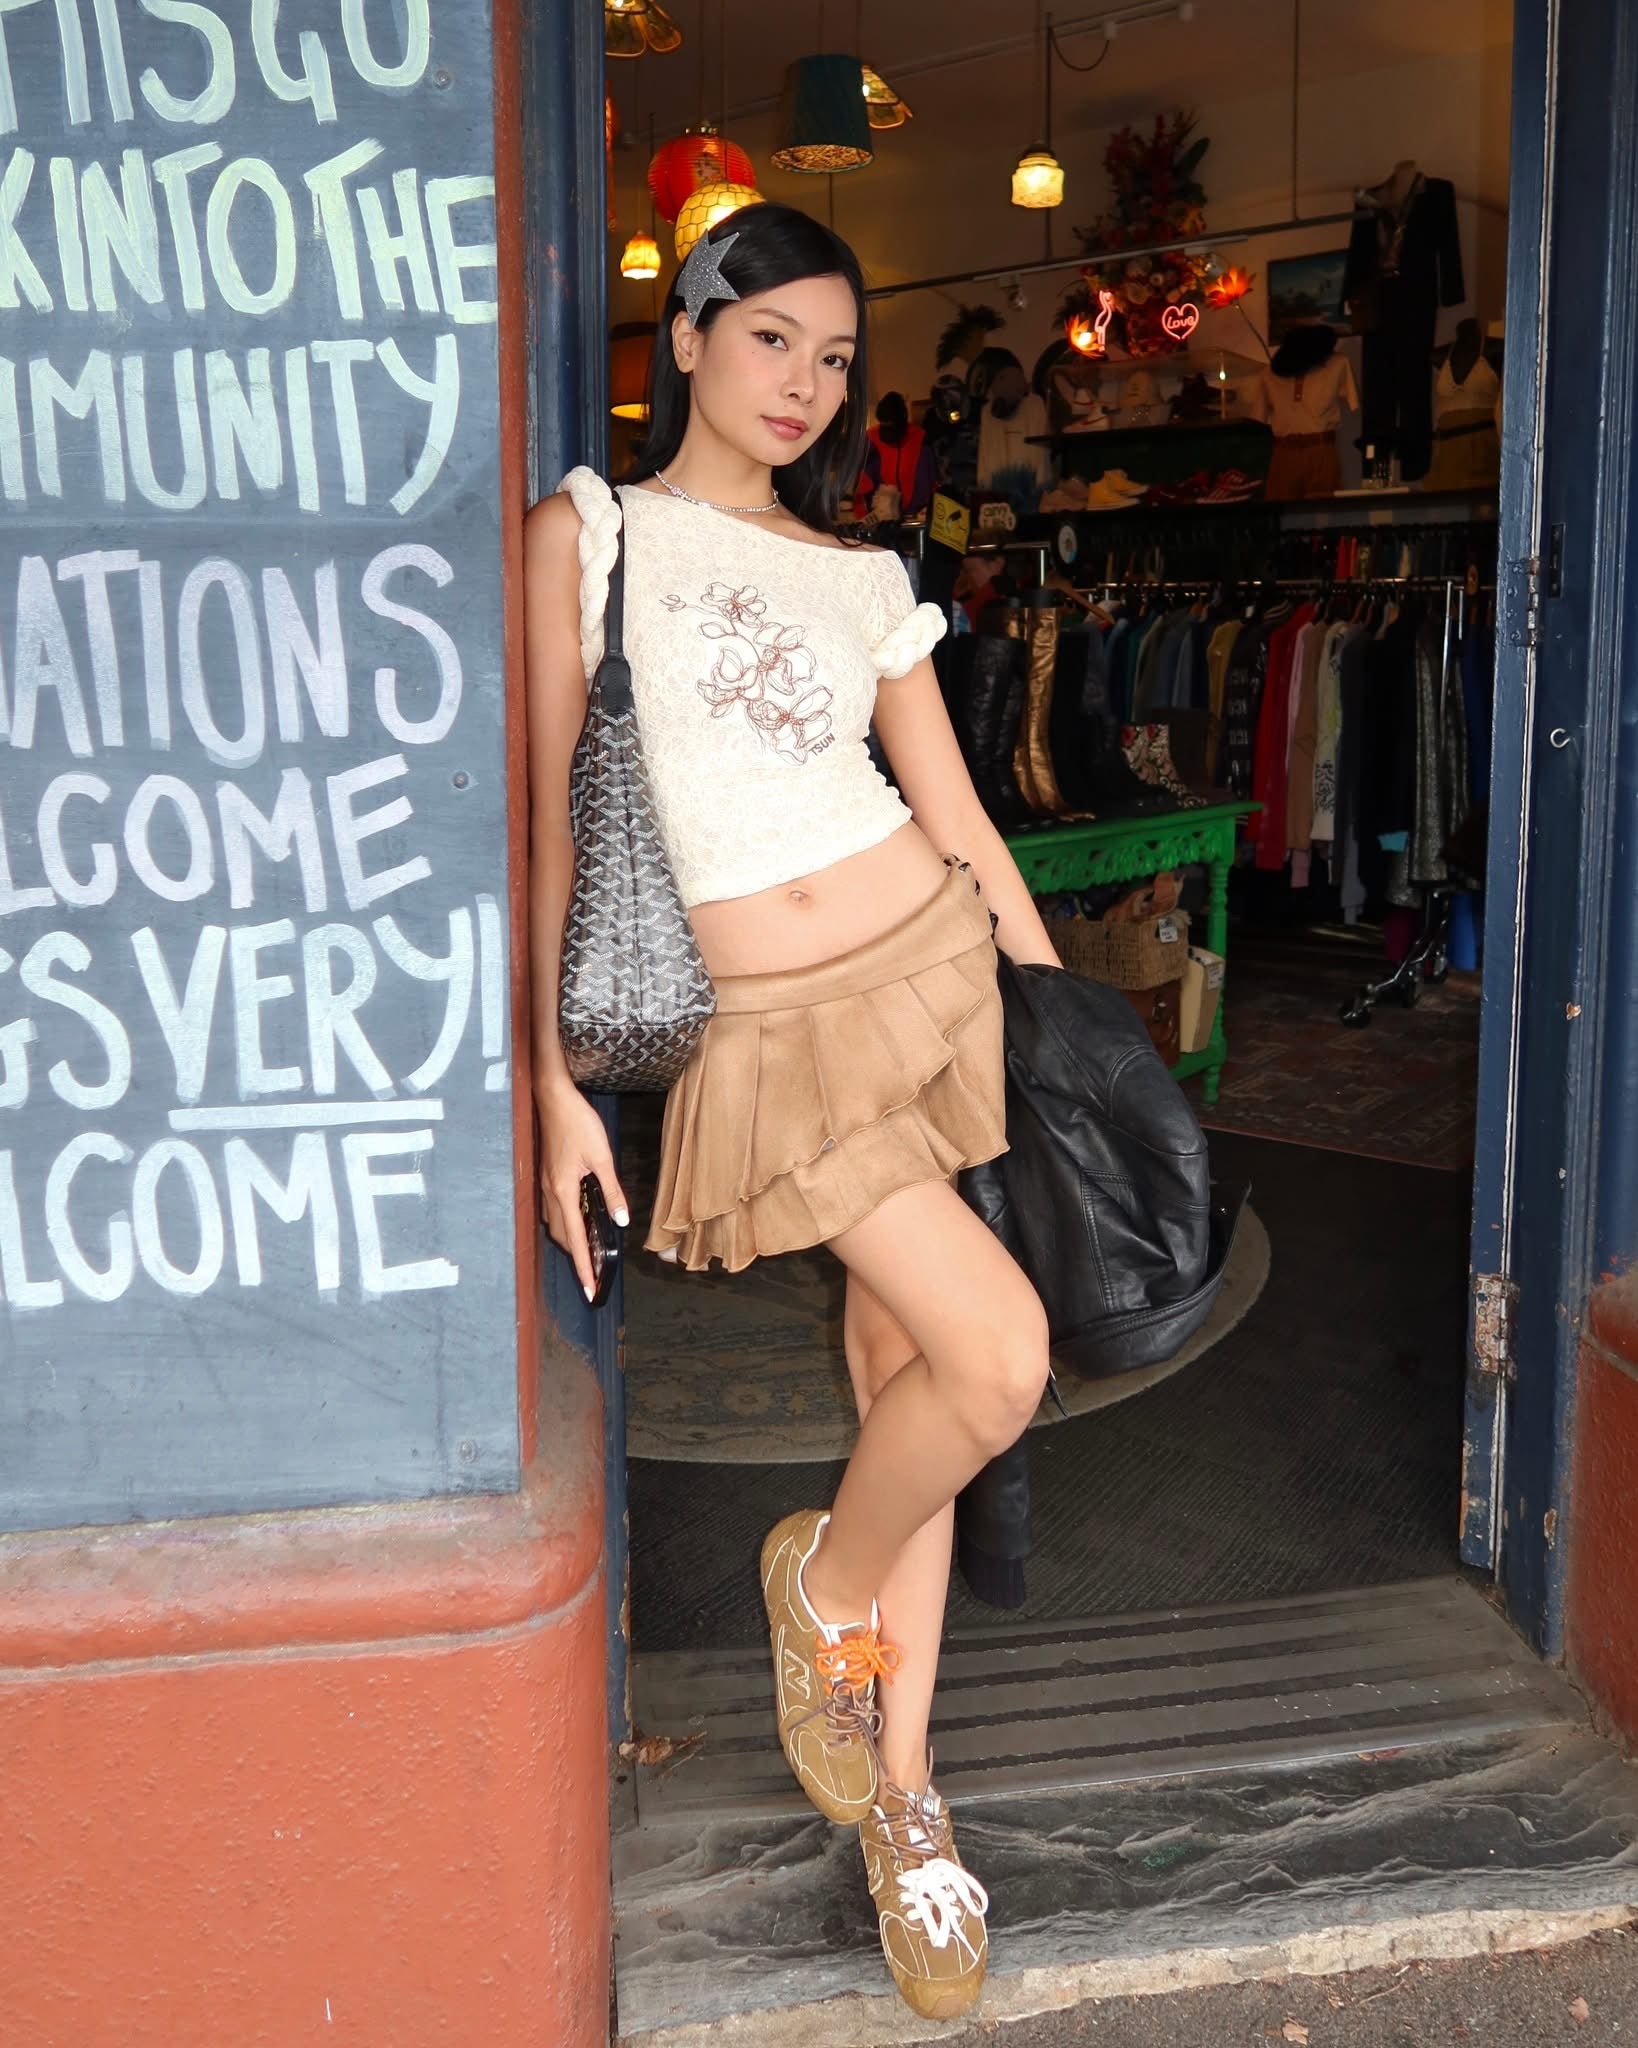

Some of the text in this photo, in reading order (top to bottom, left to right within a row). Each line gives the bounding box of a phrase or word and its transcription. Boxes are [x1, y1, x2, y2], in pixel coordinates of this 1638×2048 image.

[50, 141, 296, 314] INTO
[303, 138, 498, 324] THE
[1167, 315, 1195, 329] Love
[0, 544, 462, 768] ATIONS
[809, 732, 836, 756] TSUN
[131, 894, 509, 1102] VERY!
